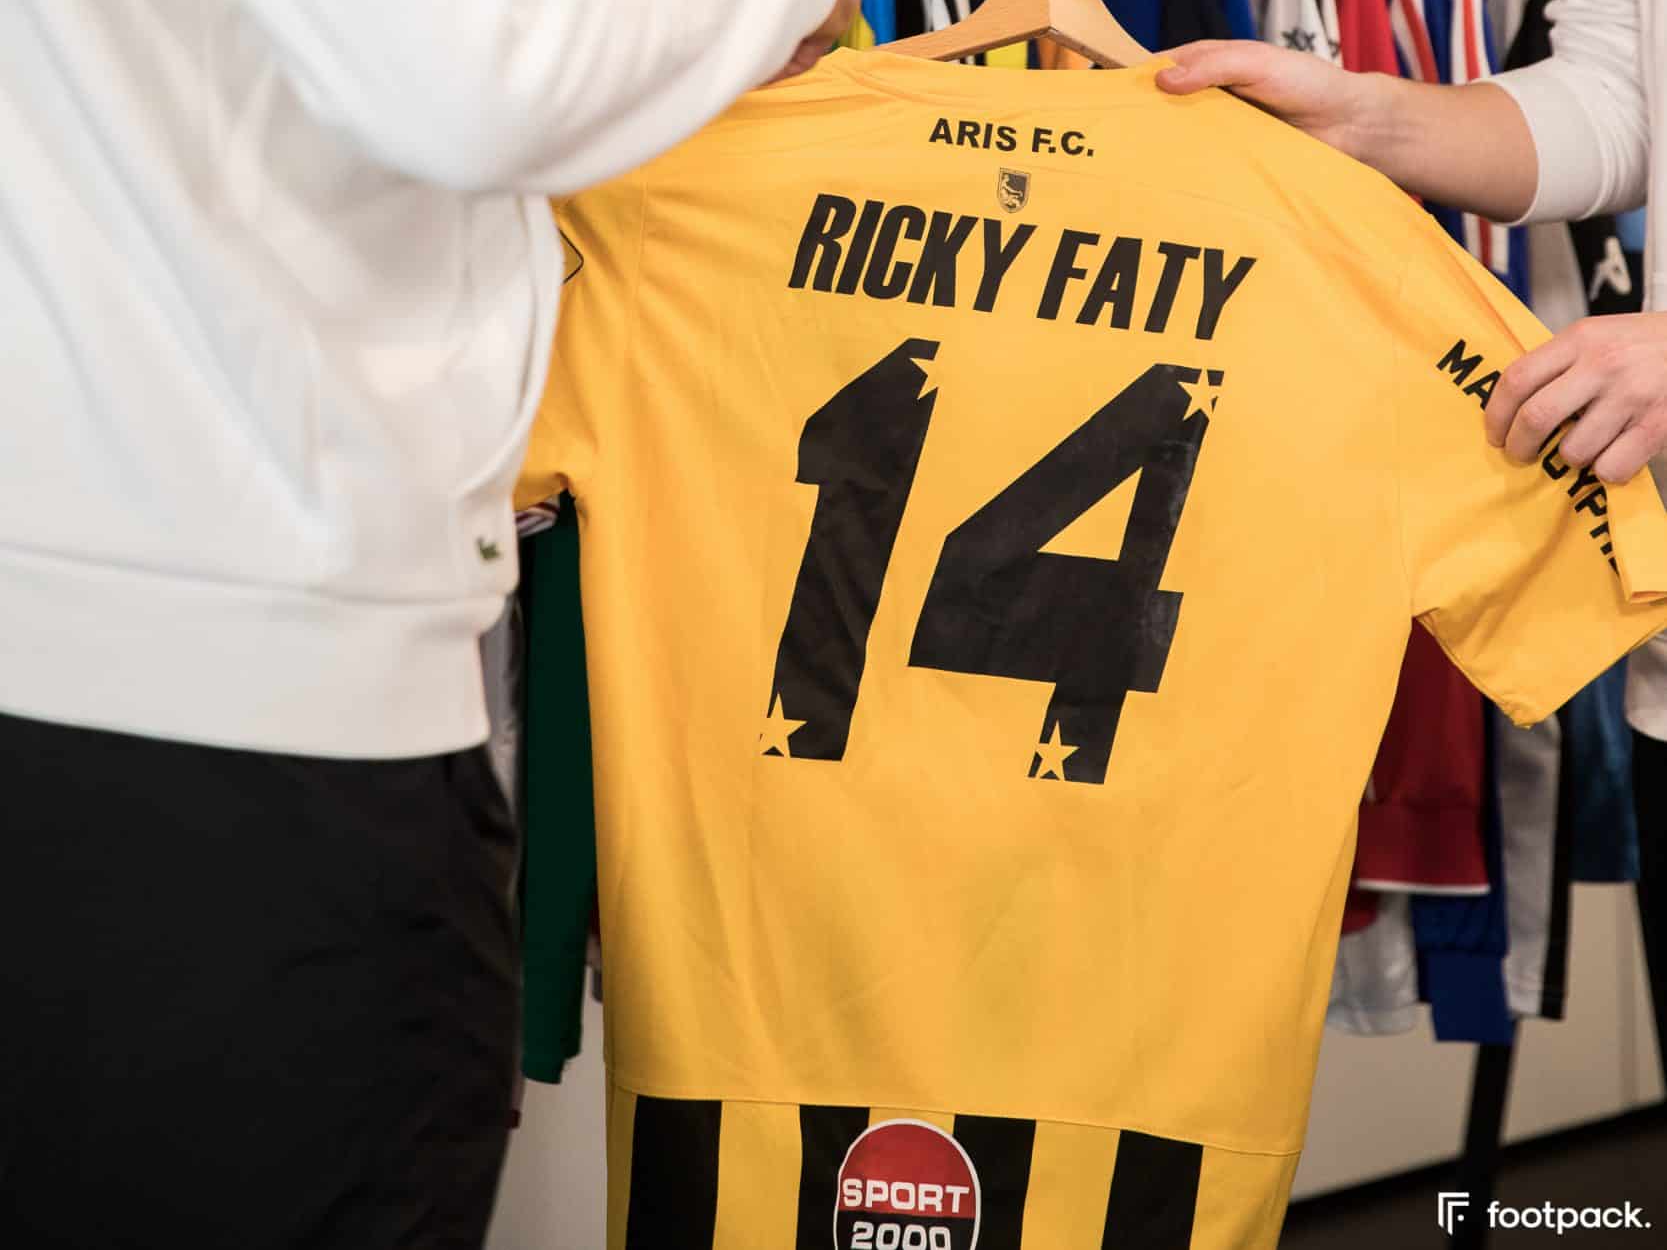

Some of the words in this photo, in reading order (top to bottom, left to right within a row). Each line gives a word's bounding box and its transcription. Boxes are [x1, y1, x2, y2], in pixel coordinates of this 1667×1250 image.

[929, 117, 1017, 152] ARIS
[1031, 128, 1094, 157] F.C.
[788, 193, 1037, 313] RICKY
[1036, 228, 1257, 341] FATY
[760, 337, 1224, 784] 14
[842, 1178, 970, 1213] SPORT
[850, 1221, 951, 1250] 2000
